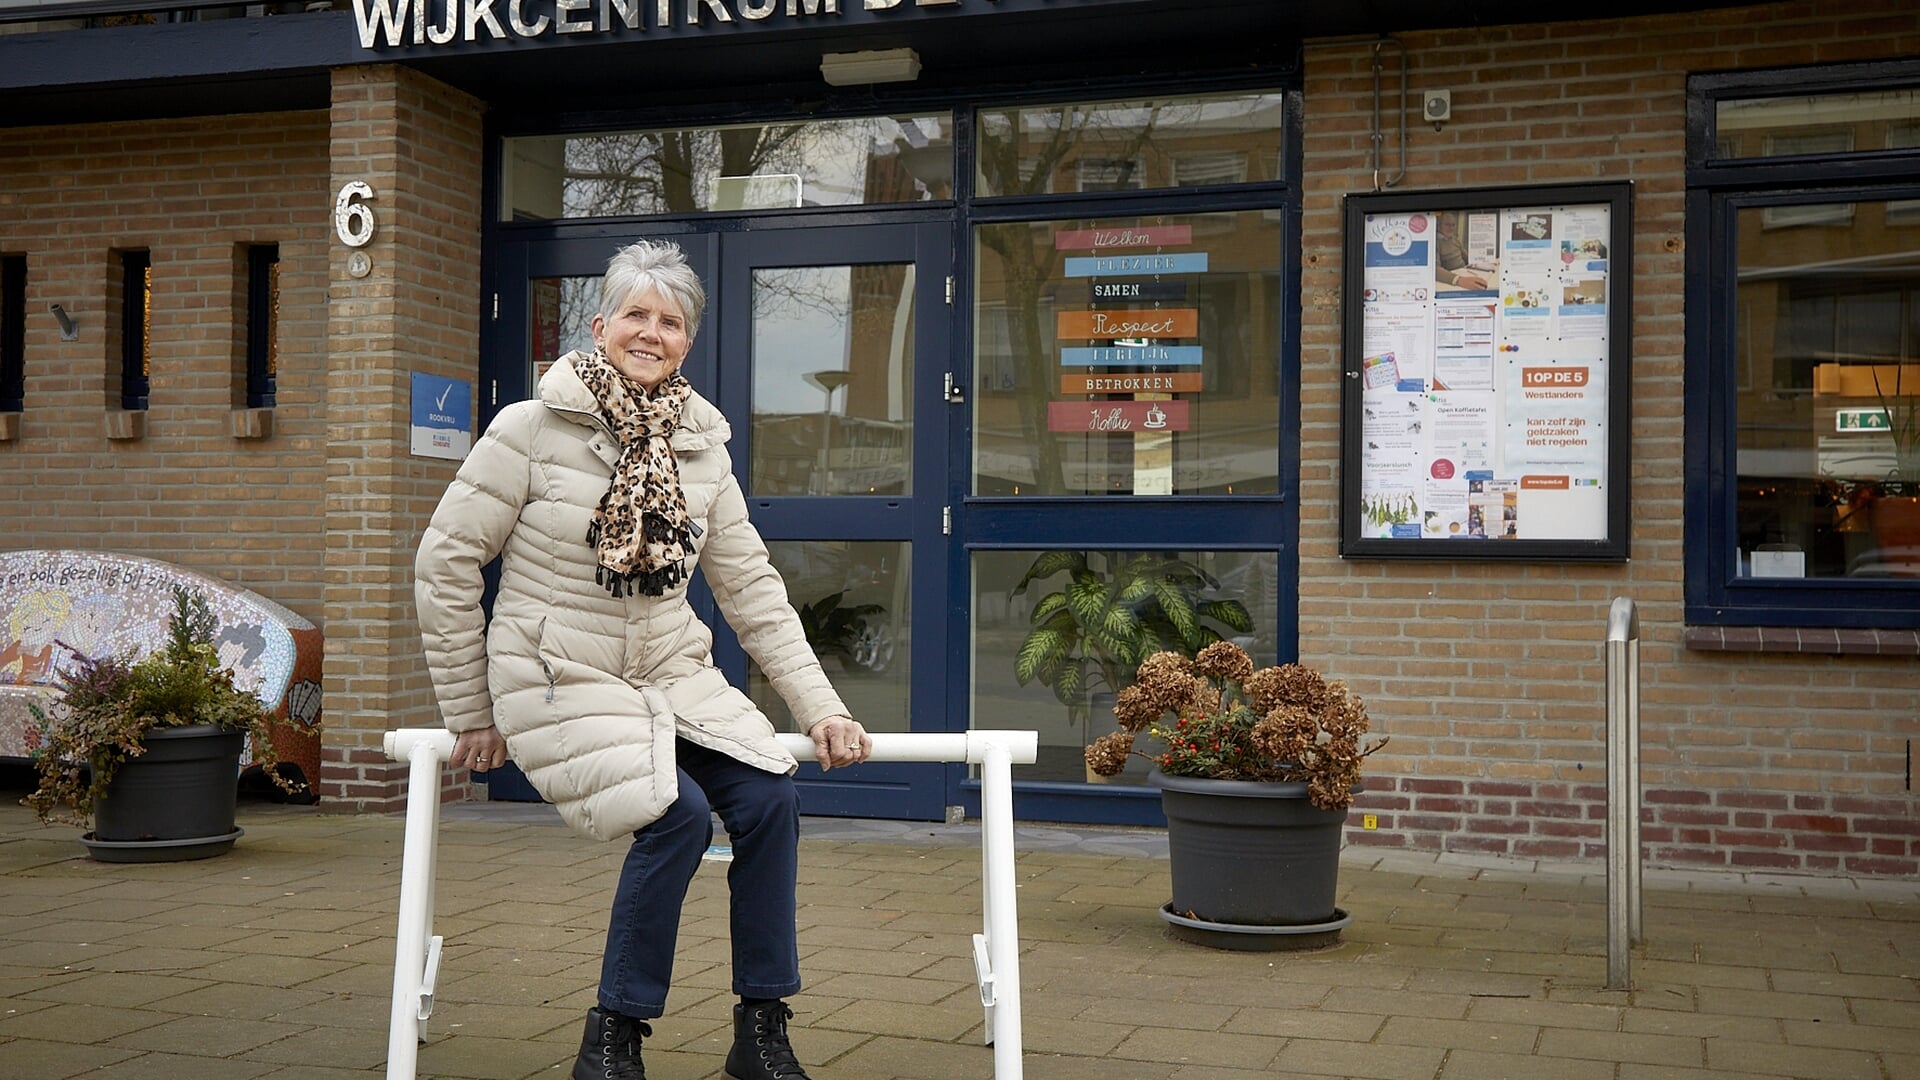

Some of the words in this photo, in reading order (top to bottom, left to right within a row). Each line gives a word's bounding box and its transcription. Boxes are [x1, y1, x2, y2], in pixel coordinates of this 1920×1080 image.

[353, 0, 843, 48] WIJKCEN
[335, 181, 374, 247] 6
[1094, 231, 1150, 246] Welkom
[1096, 256, 1175, 271] PLEZIER
[1095, 284, 1140, 297] SAMEN
[1092, 314, 1174, 337] Respect
[1086, 377, 1173, 390] BETROKKEN
[1533, 372, 1553, 383] OP
[1554, 372, 1572, 383] DE
[1574, 372, 1583, 383] 5
[1525, 391, 1584, 399] Westlanders
[429, 413, 456, 424] ROOKVRIJ
[1089, 408, 1132, 431] Koffie
[1527, 418, 1546, 426] kan
[1547, 417, 1567, 426] zelf
[1568, 417, 1586, 428] zijn
[1526, 428, 1579, 437] geldzaken
[1526, 438, 1546, 446] niet
[1548, 438, 1588, 447] regelen
[9, 572, 25, 585] er
[30, 562, 57, 585] ook
[60, 565, 121, 587] gezellig
[123, 567, 144, 590] bij
